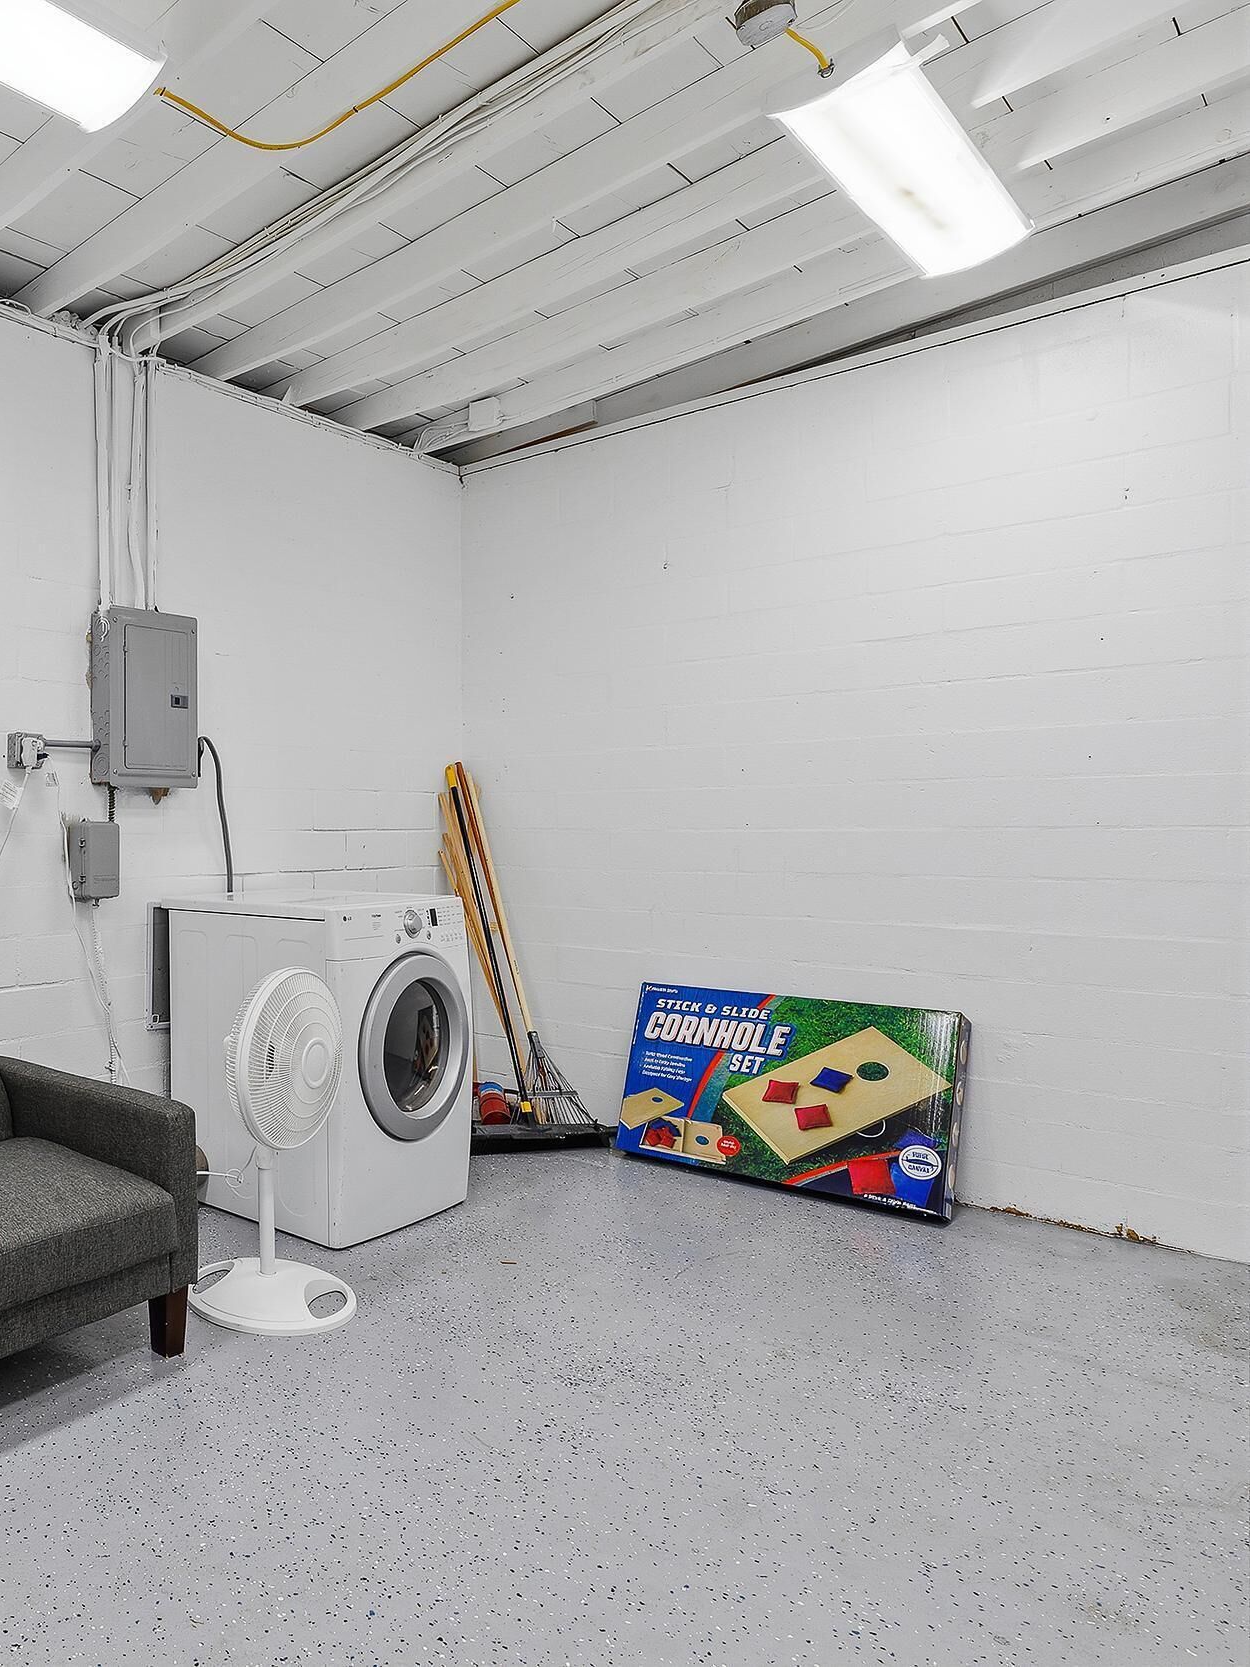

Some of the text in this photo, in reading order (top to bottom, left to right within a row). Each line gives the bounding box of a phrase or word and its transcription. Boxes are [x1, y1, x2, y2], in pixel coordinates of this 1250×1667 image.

[656, 999, 771, 1020] STICK & SLIDE
[644, 1012, 791, 1057] CORNHOLE
[729, 1054, 765, 1075] SET
